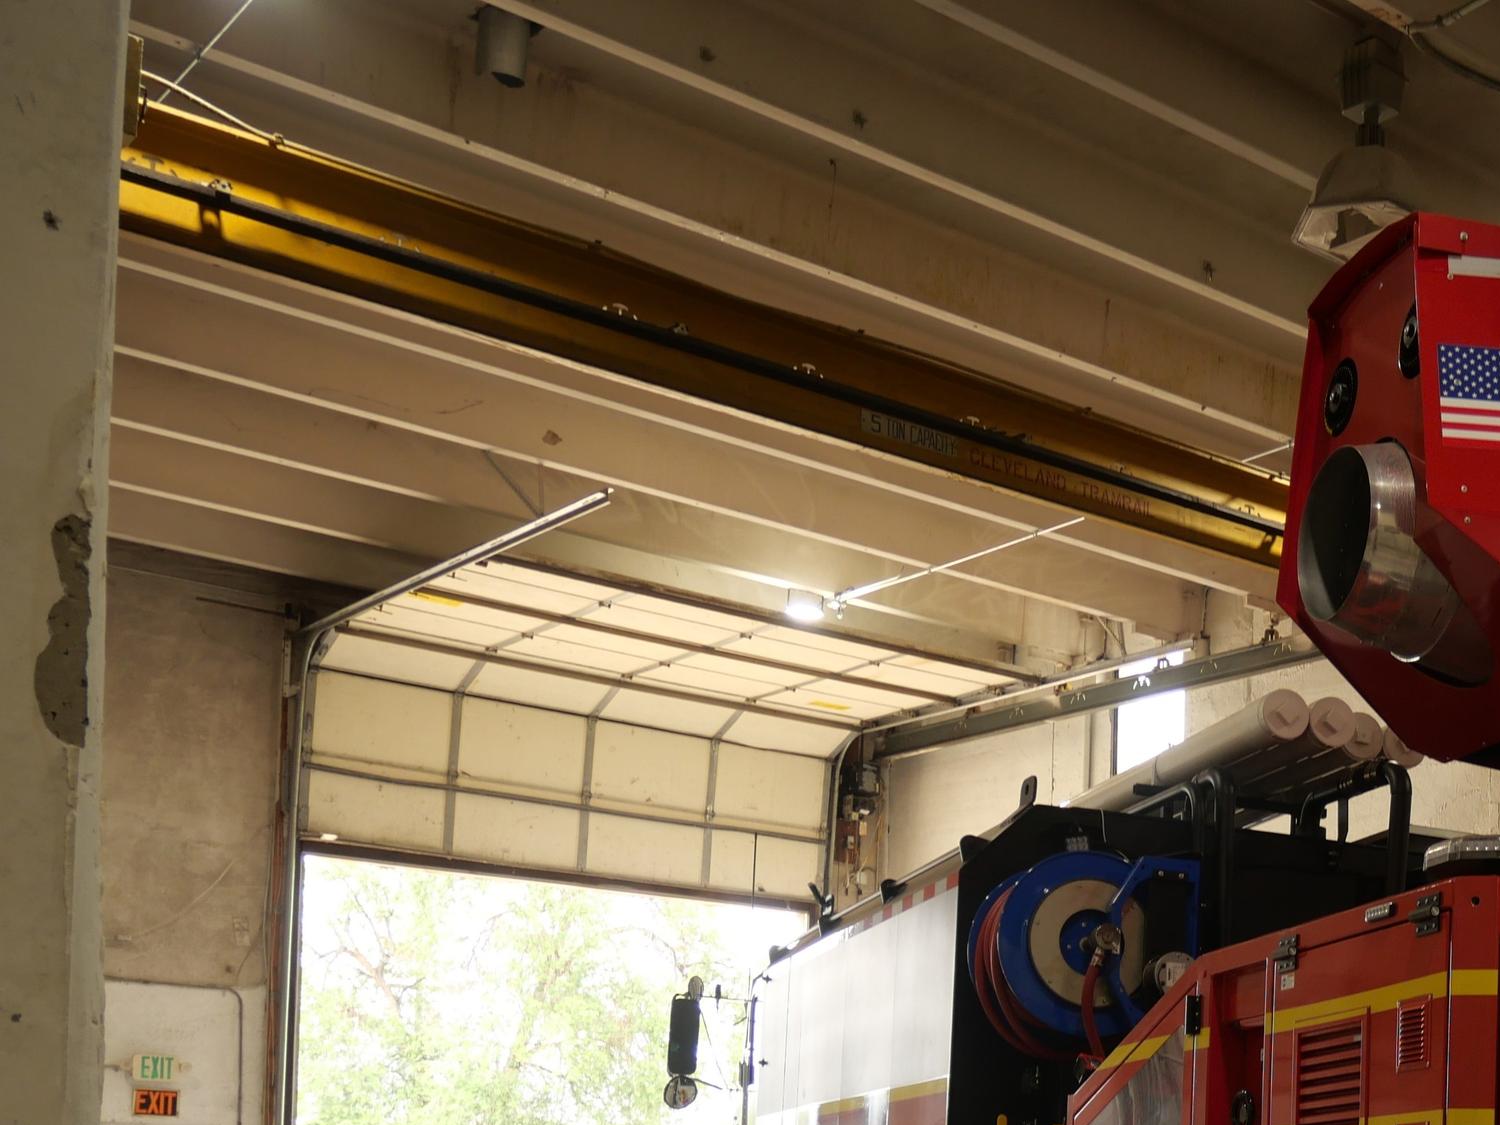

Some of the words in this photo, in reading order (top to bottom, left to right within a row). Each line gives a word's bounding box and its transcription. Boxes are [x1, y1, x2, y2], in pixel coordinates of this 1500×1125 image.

[870, 414, 881, 433] 5
[887, 417, 906, 441] TON
[910, 425, 959, 456] CAPACITY
[968, 447, 1066, 491] CLEVELAND
[1080, 480, 1153, 518] TRAMRAIL
[141, 1055, 174, 1079] EXIT
[135, 1091, 177, 1116] EXIT
